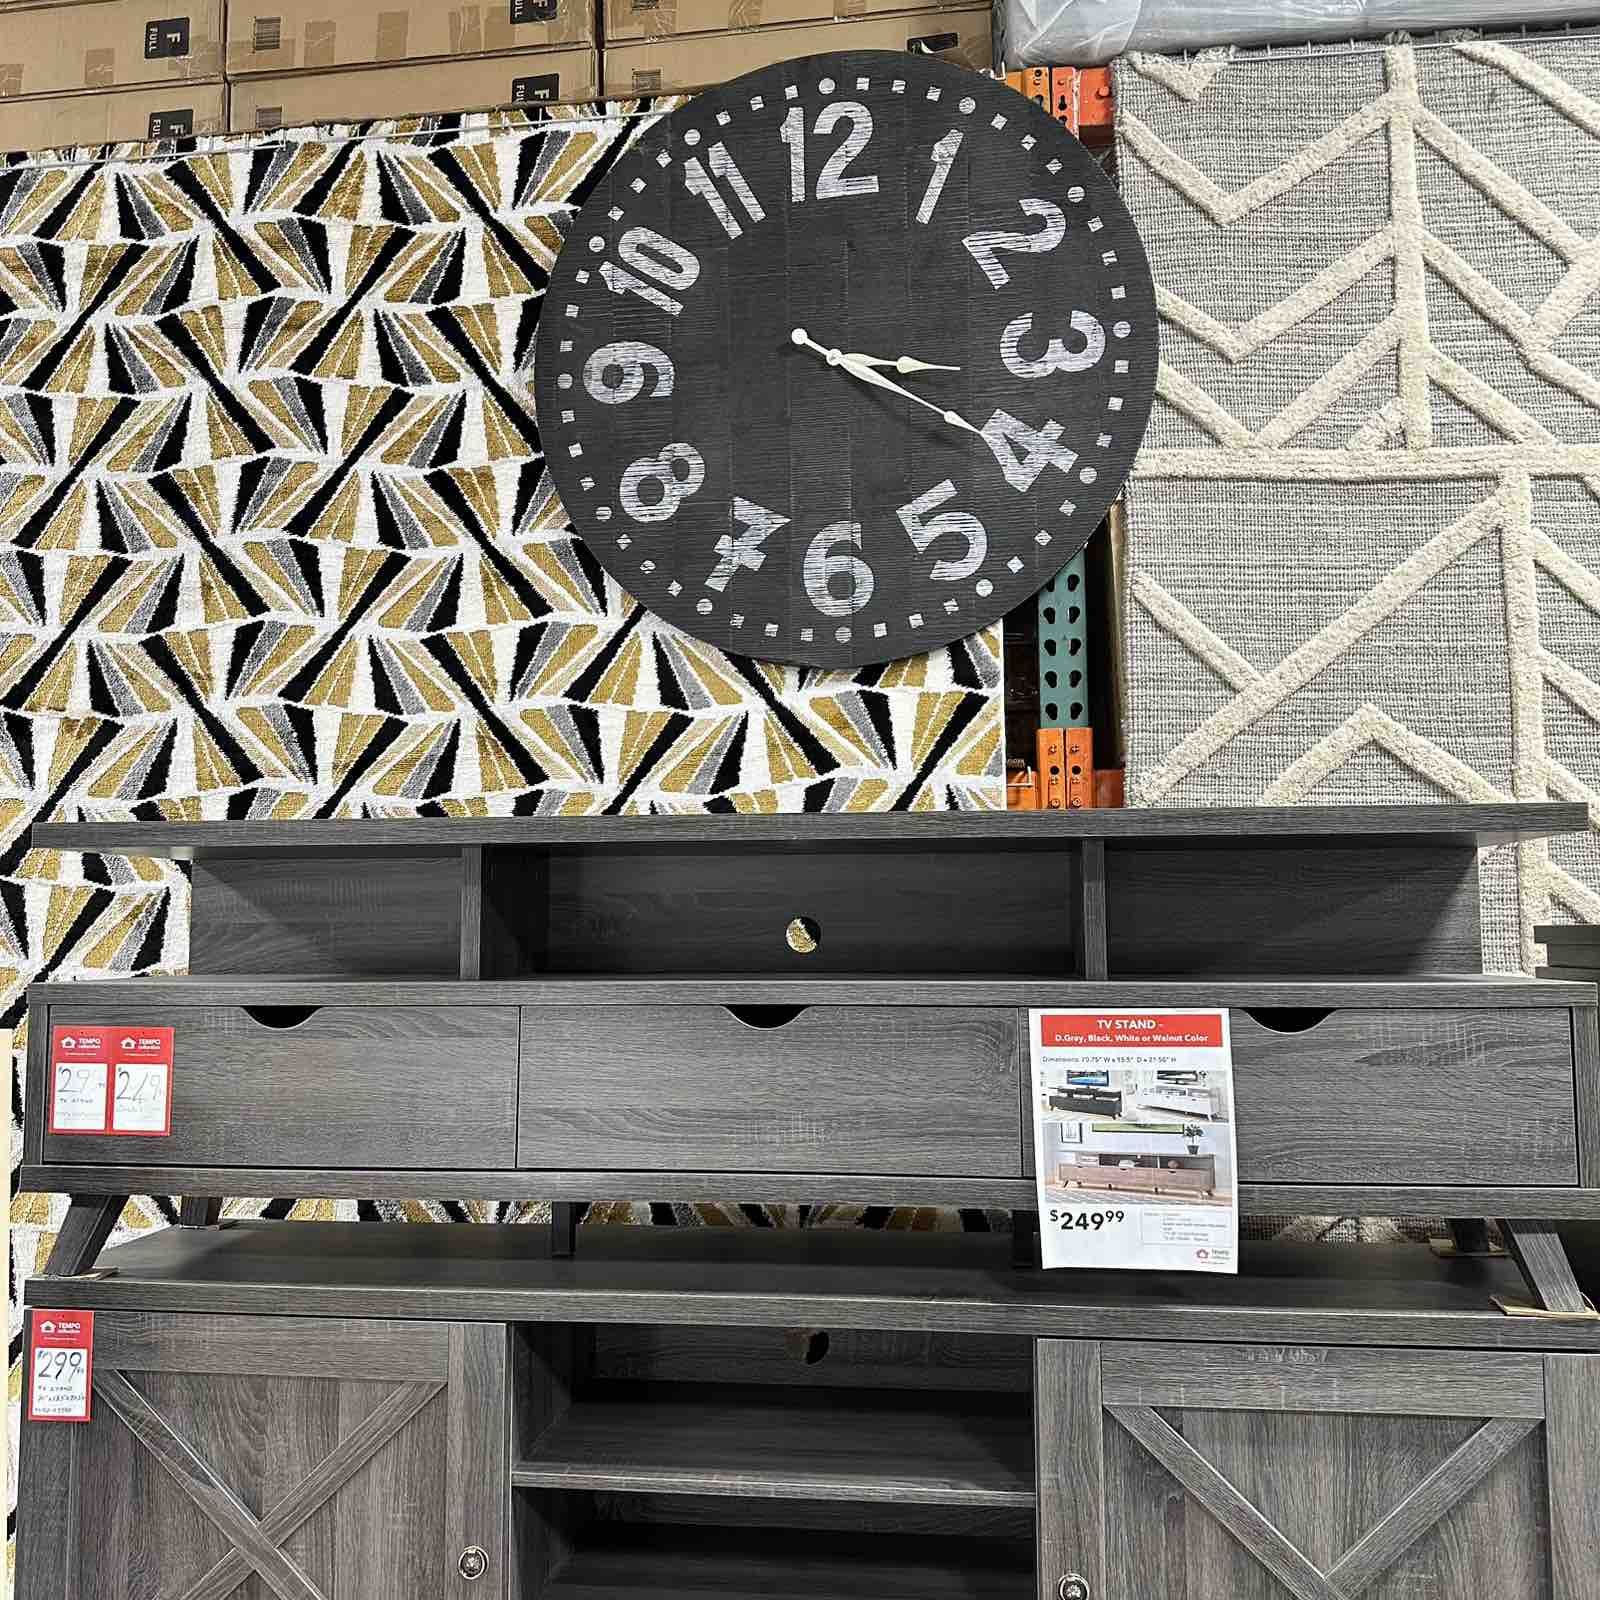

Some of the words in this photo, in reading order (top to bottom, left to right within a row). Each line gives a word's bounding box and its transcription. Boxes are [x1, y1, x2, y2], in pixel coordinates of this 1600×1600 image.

[149, 27, 159, 53] FULL
[166, 32, 181, 43] F
[514, 0, 524, 18] ULL
[169, 123, 185, 134] F
[534, 88, 550, 99] F
[683, 141, 767, 240] 11
[780, 101, 879, 202] 12
[915, 129, 964, 225] 1
[600, 226, 700, 317] 10
[962, 198, 1067, 290] 2
[583, 341, 675, 405] 9
[1000, 310, 1106, 379] 3
[619, 442, 706, 523] 8
[980, 408, 1079, 493] 4
[704, 496, 792, 593] 7
[803, 520, 875, 617] 6
[896, 478, 988, 581] 5
[1096, 1019, 1113, 1029] TV
[1115, 1019, 1157, 1030] STAND
[1115, 1033, 1141, 1042] White
[1152, 1033, 1183, 1042] Walnut
[1184, 1033, 1209, 1043] Color
